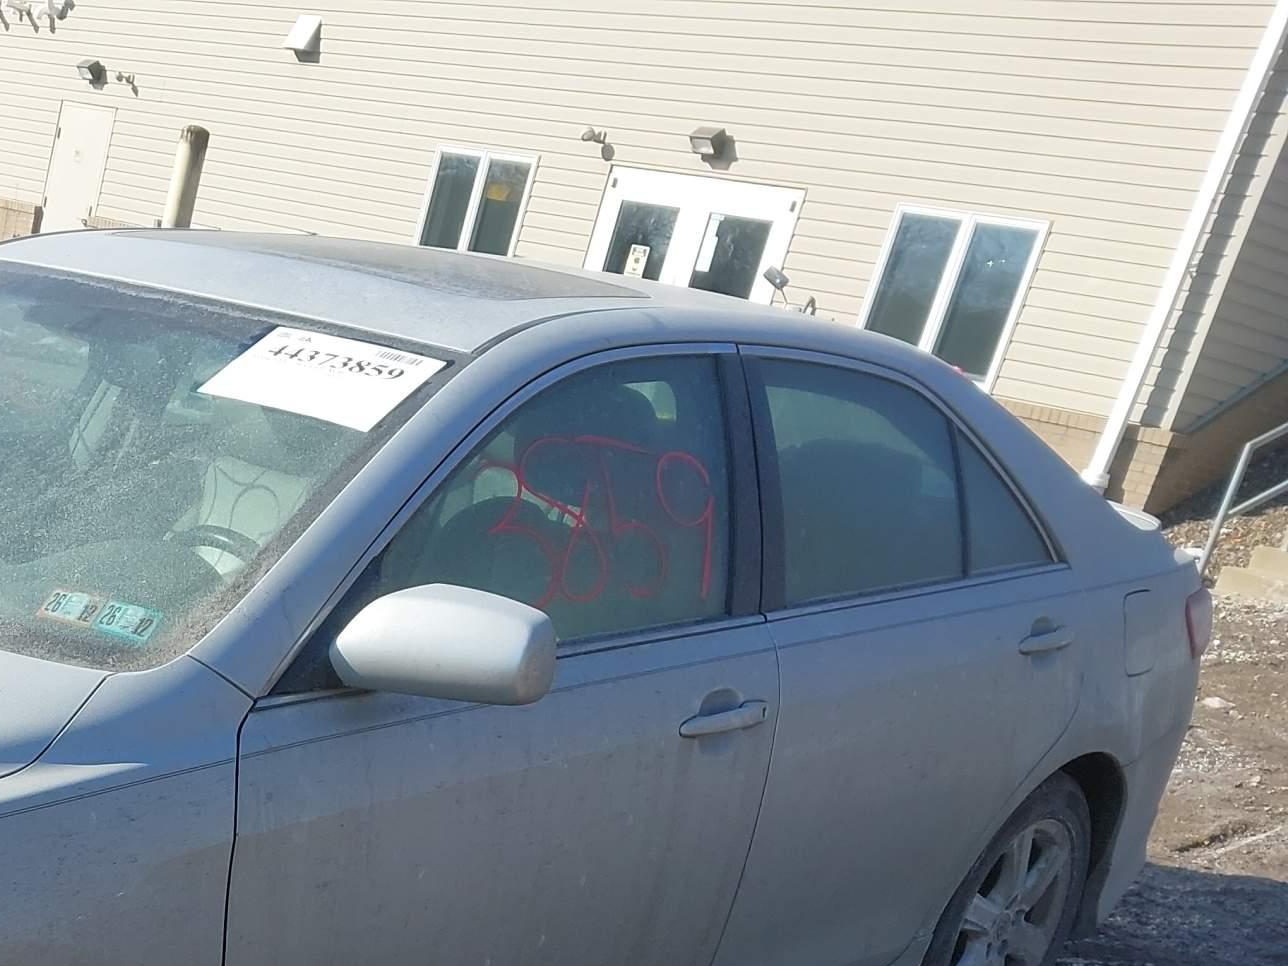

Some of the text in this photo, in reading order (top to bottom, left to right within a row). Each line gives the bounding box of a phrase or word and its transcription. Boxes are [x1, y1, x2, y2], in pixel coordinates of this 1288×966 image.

[267, 344, 405, 380] 44373859
[469, 434, 716, 611] 3859
[100, 605, 121, 626] 26
